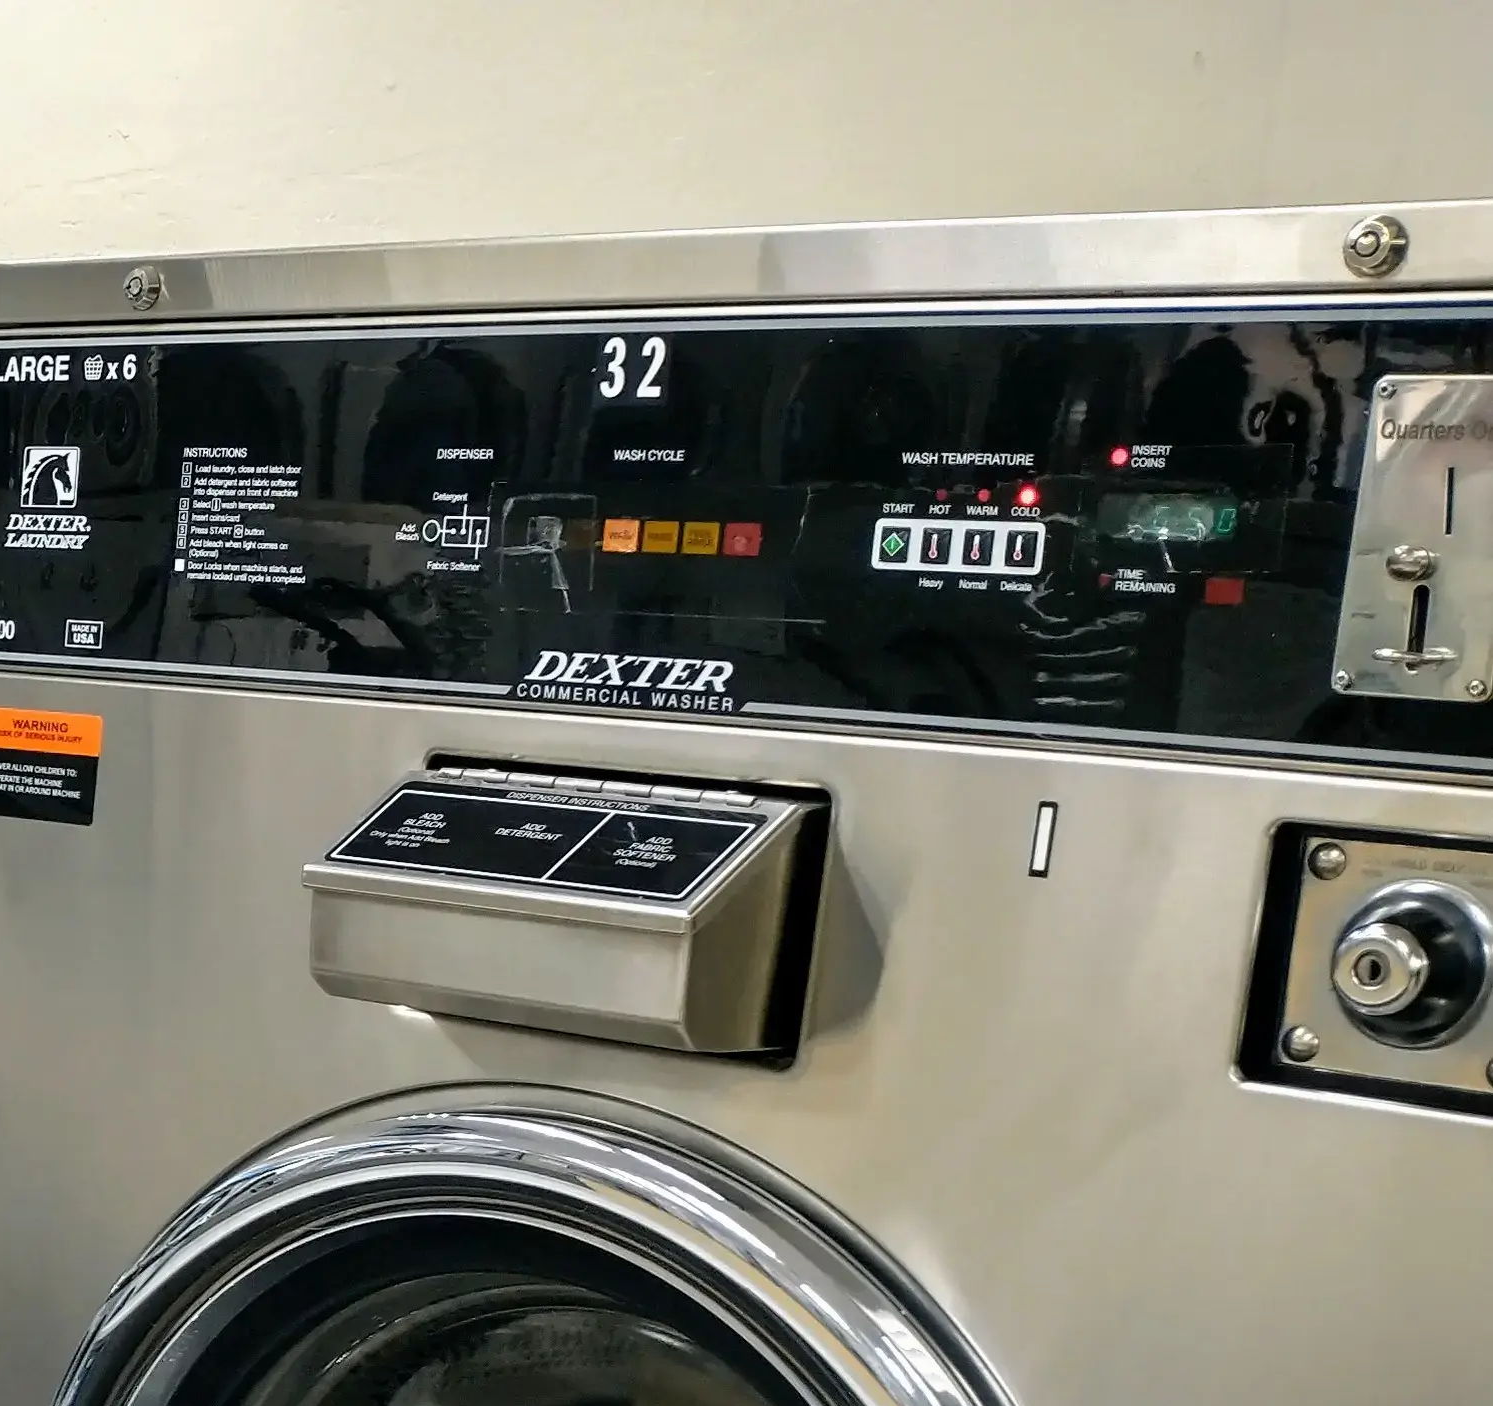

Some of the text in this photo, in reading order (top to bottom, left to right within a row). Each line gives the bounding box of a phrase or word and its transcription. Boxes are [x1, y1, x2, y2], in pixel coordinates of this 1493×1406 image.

[1381, 418, 1465, 440] Quarters
[183, 447, 248, 458] INSTRUCTIONS
[437, 448, 493, 460] DISPENSER
[614, 449, 685, 462] WASH CYCLE
[1131, 445, 1172, 455] INSERT
[902, 452, 1034, 465] WASH TEMPERATURE
[1131, 458, 1166, 468] COINS
[194, 478, 207, 486] Add
[238, 478, 250, 486] and
[432, 492, 468, 503] Detergent
[882, 503, 1040, 517] START HOT WARM COLD
[210, 526, 233, 535] START
[245, 528, 265, 536] button
[4, 532, 89, 550] LAUNDRY
[188, 561, 203, 569] Door
[427, 560, 448, 570] Fabric
[1117, 568, 1145, 579] TIME
[919, 578, 1032, 591] Heavy Normal Delicate
[1115, 581, 1176, 593] REMAINING
[73, 633, 95, 644] USA
[524, 651, 734, 693] DEXTER
[516, 683, 734, 712] COMMERCIAL WASHER
[13, 719, 68, 732] WARNING
[11, 763, 34, 773] ALLOW
[34, 766, 65, 776] CHILDREN
[34, 778, 63, 788] MACHINE
[52, 789, 81, 799] MACHINE
[506, 791, 650, 812] DISPENSER INSTRUCTIONS
[419, 812, 444, 820] ADD
[403, 819, 447, 829] BLEACH
[520, 823, 546, 831] ADD
[495, 828, 564, 841] DETERGENT
[646, 837, 674, 845] ADD
[629, 843, 674, 853] FABRIC
[613, 849, 677, 862] SOFTENER
[615, 858, 657, 869] (Optional)
